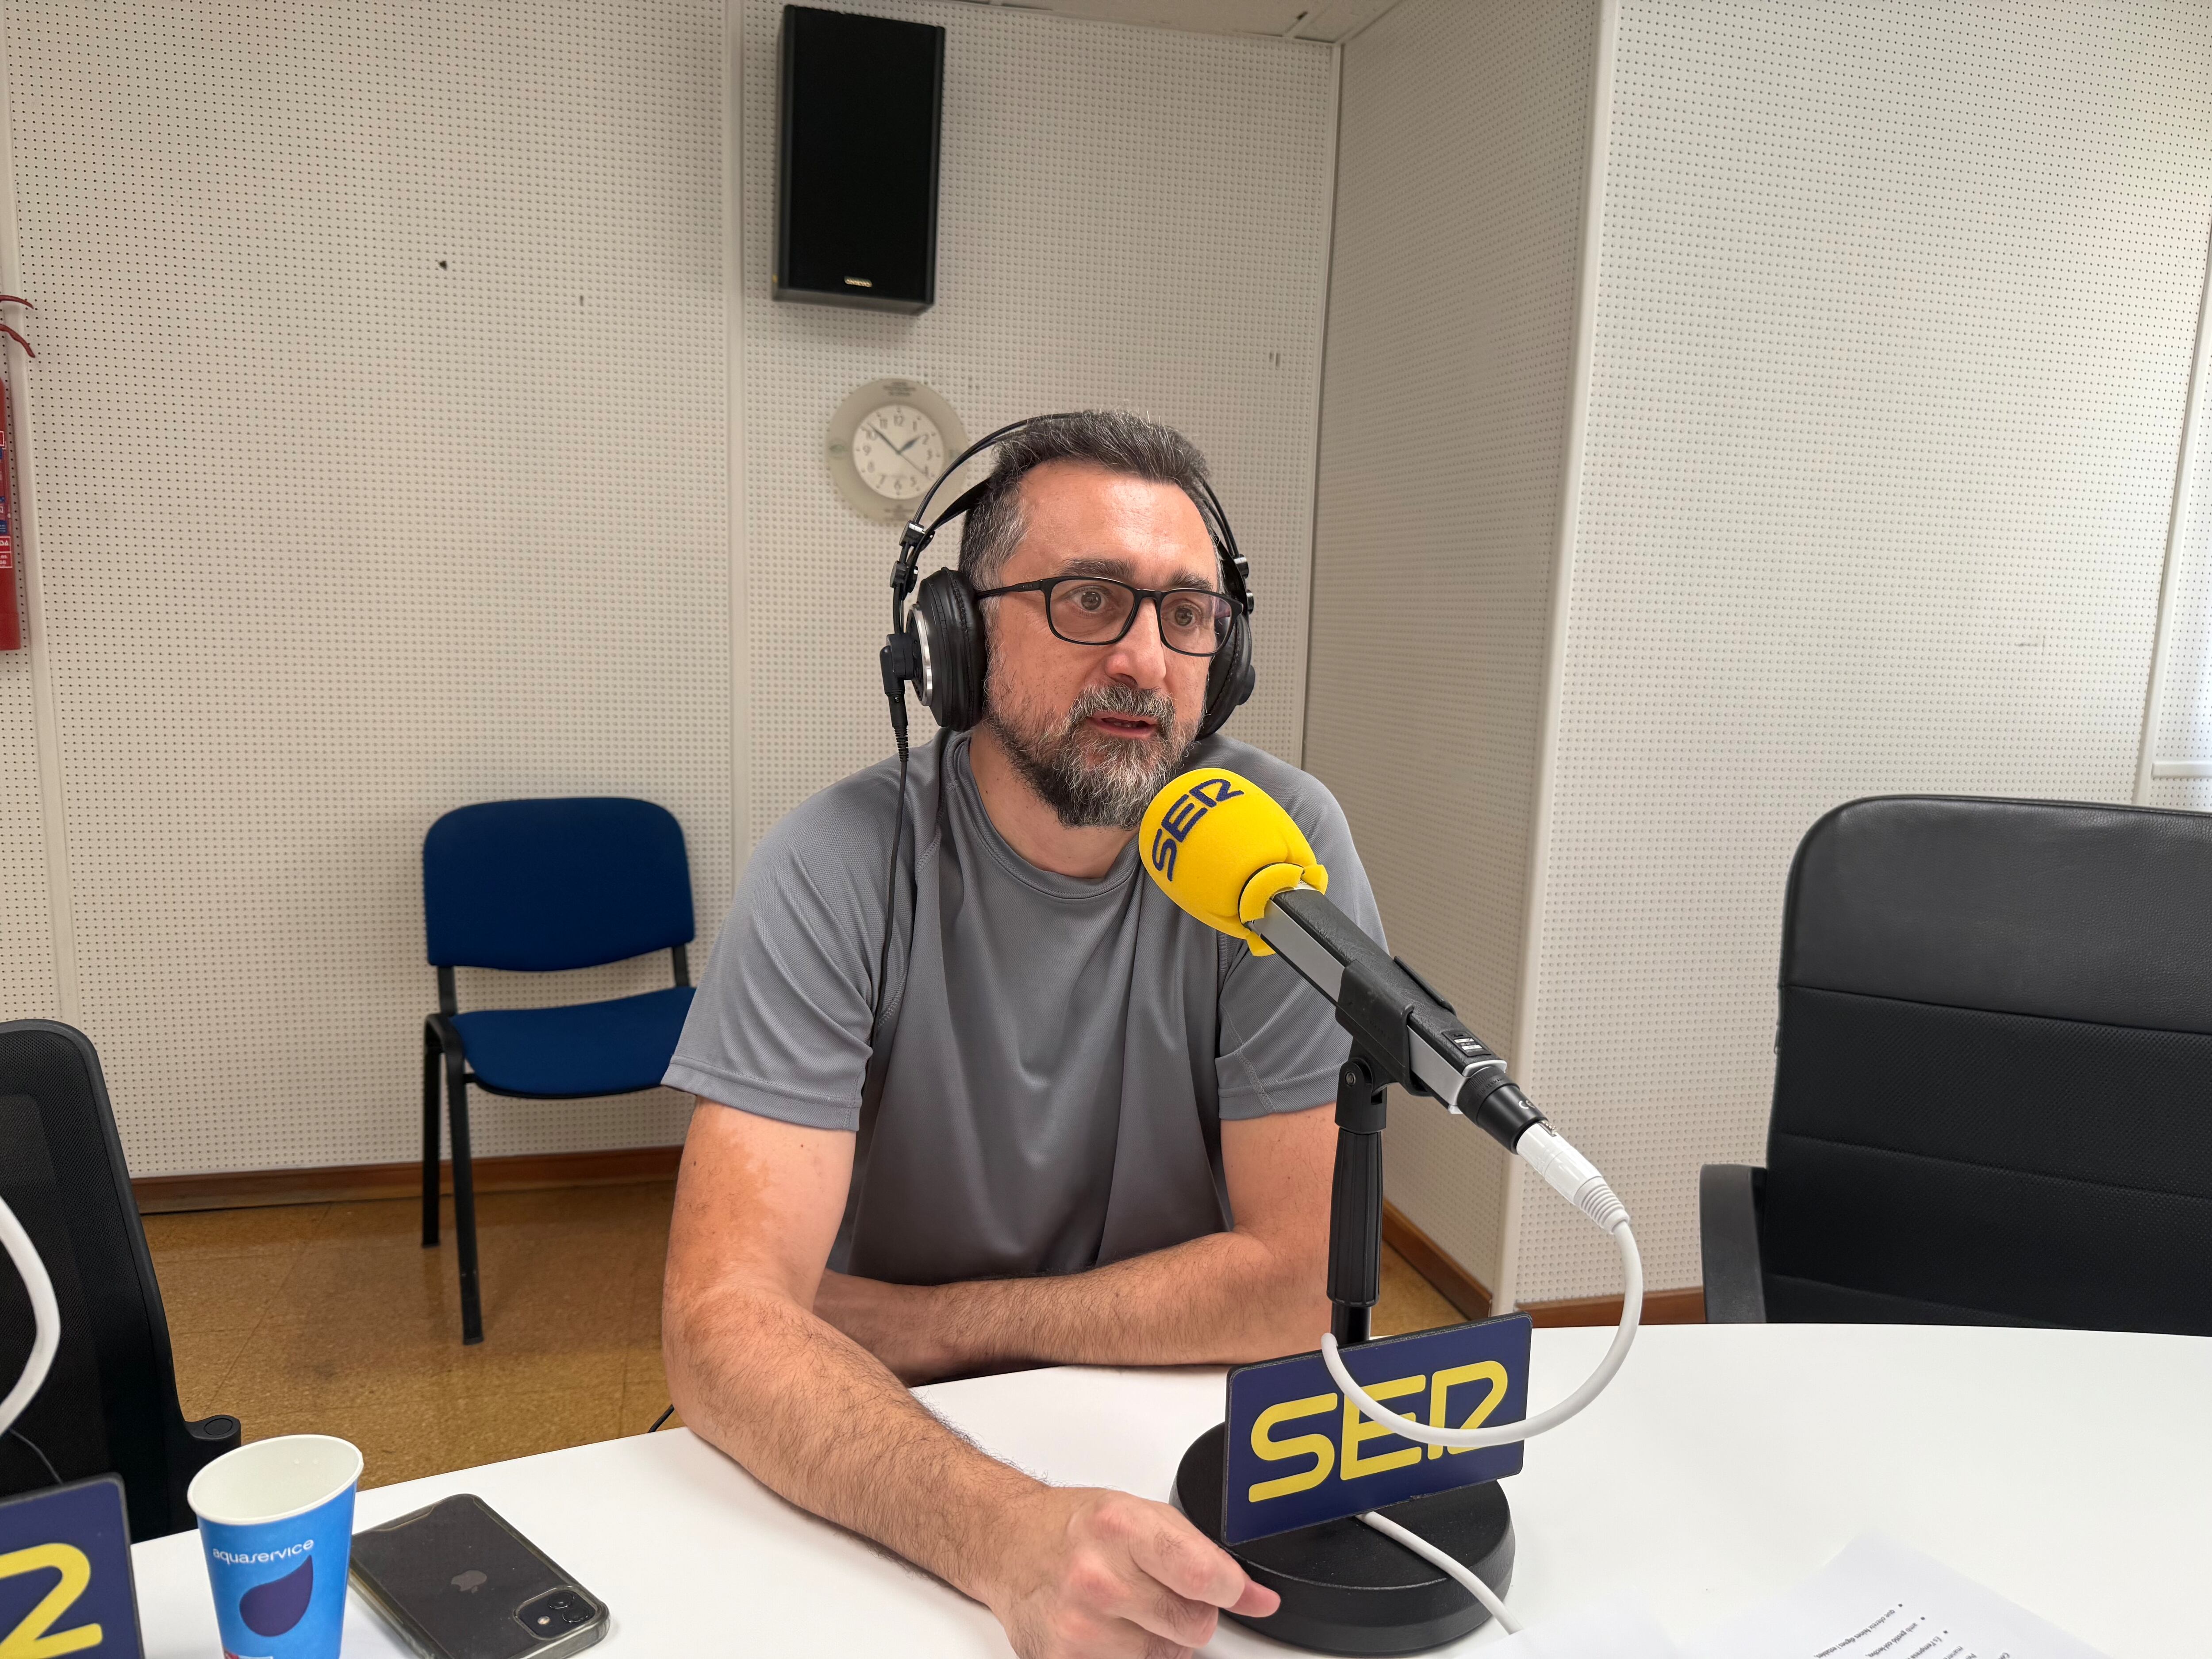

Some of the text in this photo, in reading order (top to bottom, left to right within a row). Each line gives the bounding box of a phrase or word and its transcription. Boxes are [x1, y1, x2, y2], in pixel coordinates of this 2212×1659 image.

[879, 419, 888, 430] 11
[894, 415, 904, 427] 12
[912, 421, 917, 432] 1
[863, 444, 871, 456] 9
[927, 449, 933, 460] 3
[1152, 779, 1244, 881] SER
[1248, 1360, 1508, 1502] SER
[213, 1539, 314, 1565] aquaservice
[1884, 1609, 1895, 1618] que
[1905, 1622, 1918, 1632] amb
